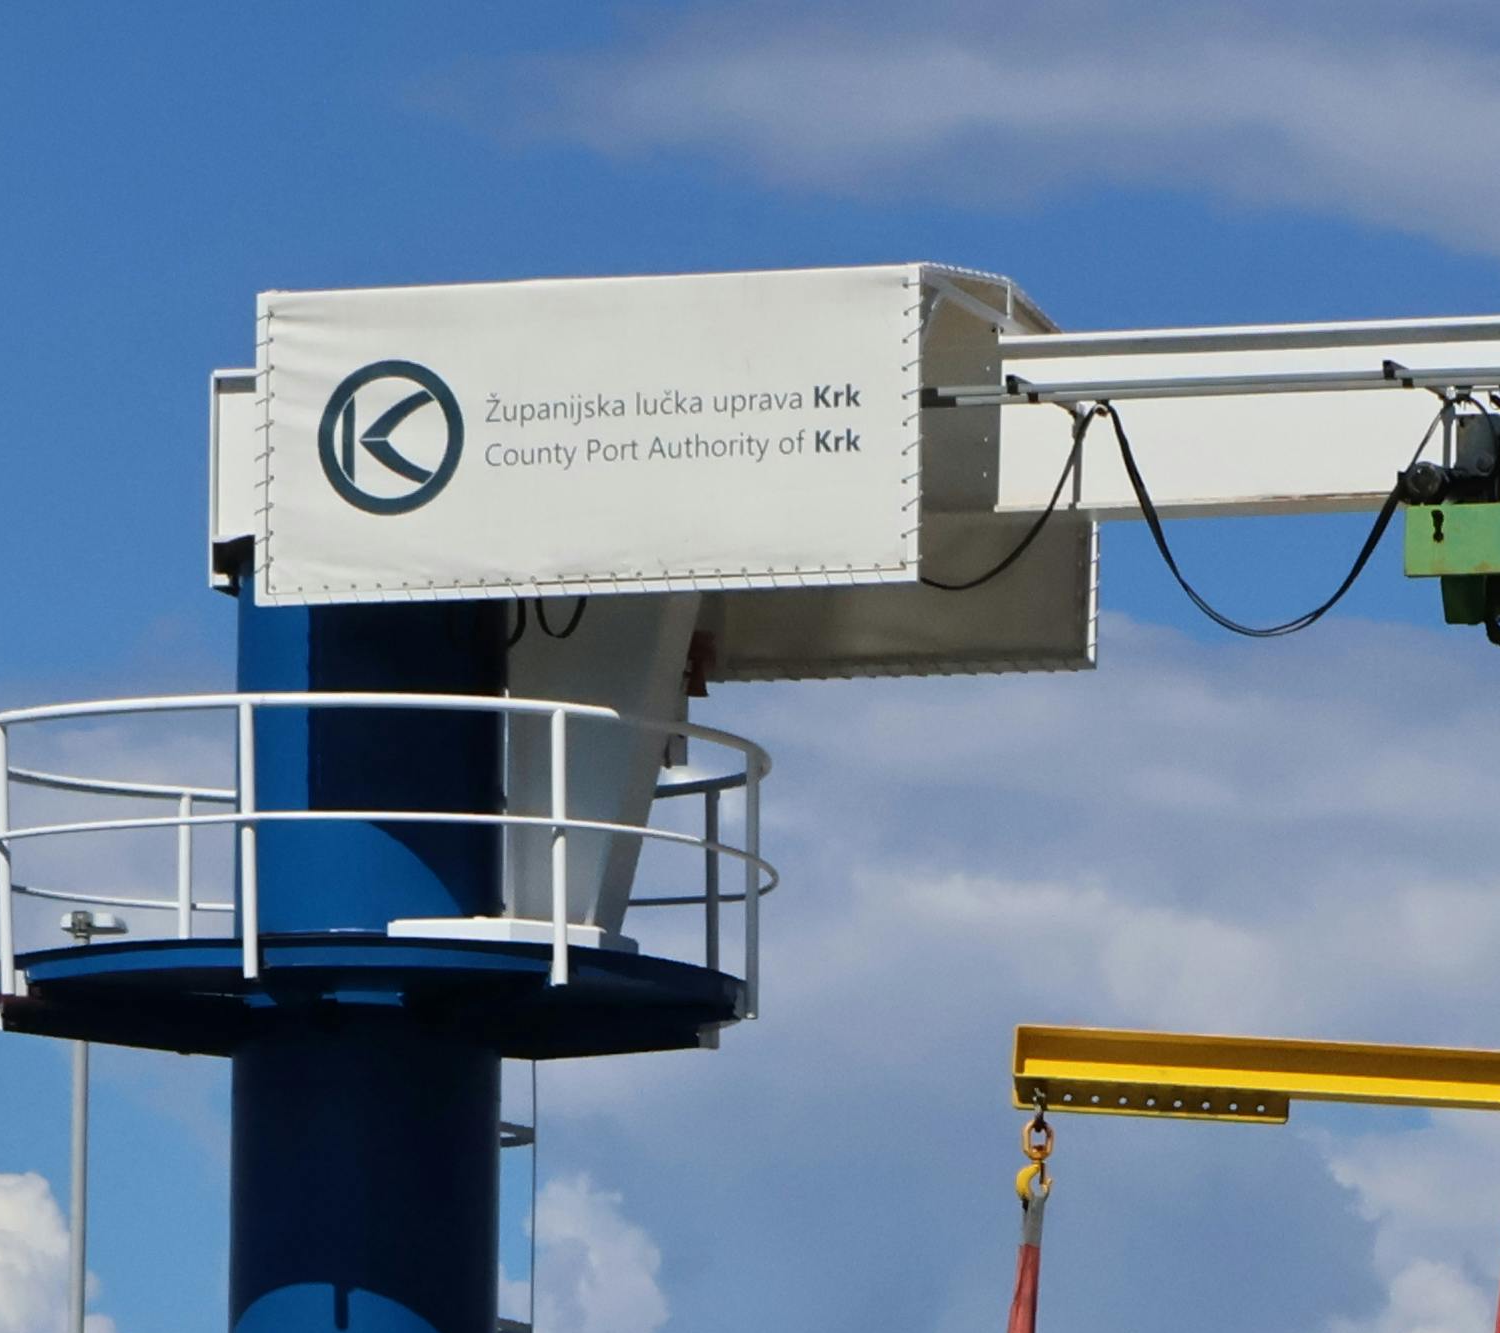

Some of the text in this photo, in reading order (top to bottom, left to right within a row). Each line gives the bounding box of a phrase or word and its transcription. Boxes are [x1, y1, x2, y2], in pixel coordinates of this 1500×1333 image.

[484, 383, 862, 428] Županijska lučka uprava Krk
[484, 428, 861, 471] County Port Authority of Krk
